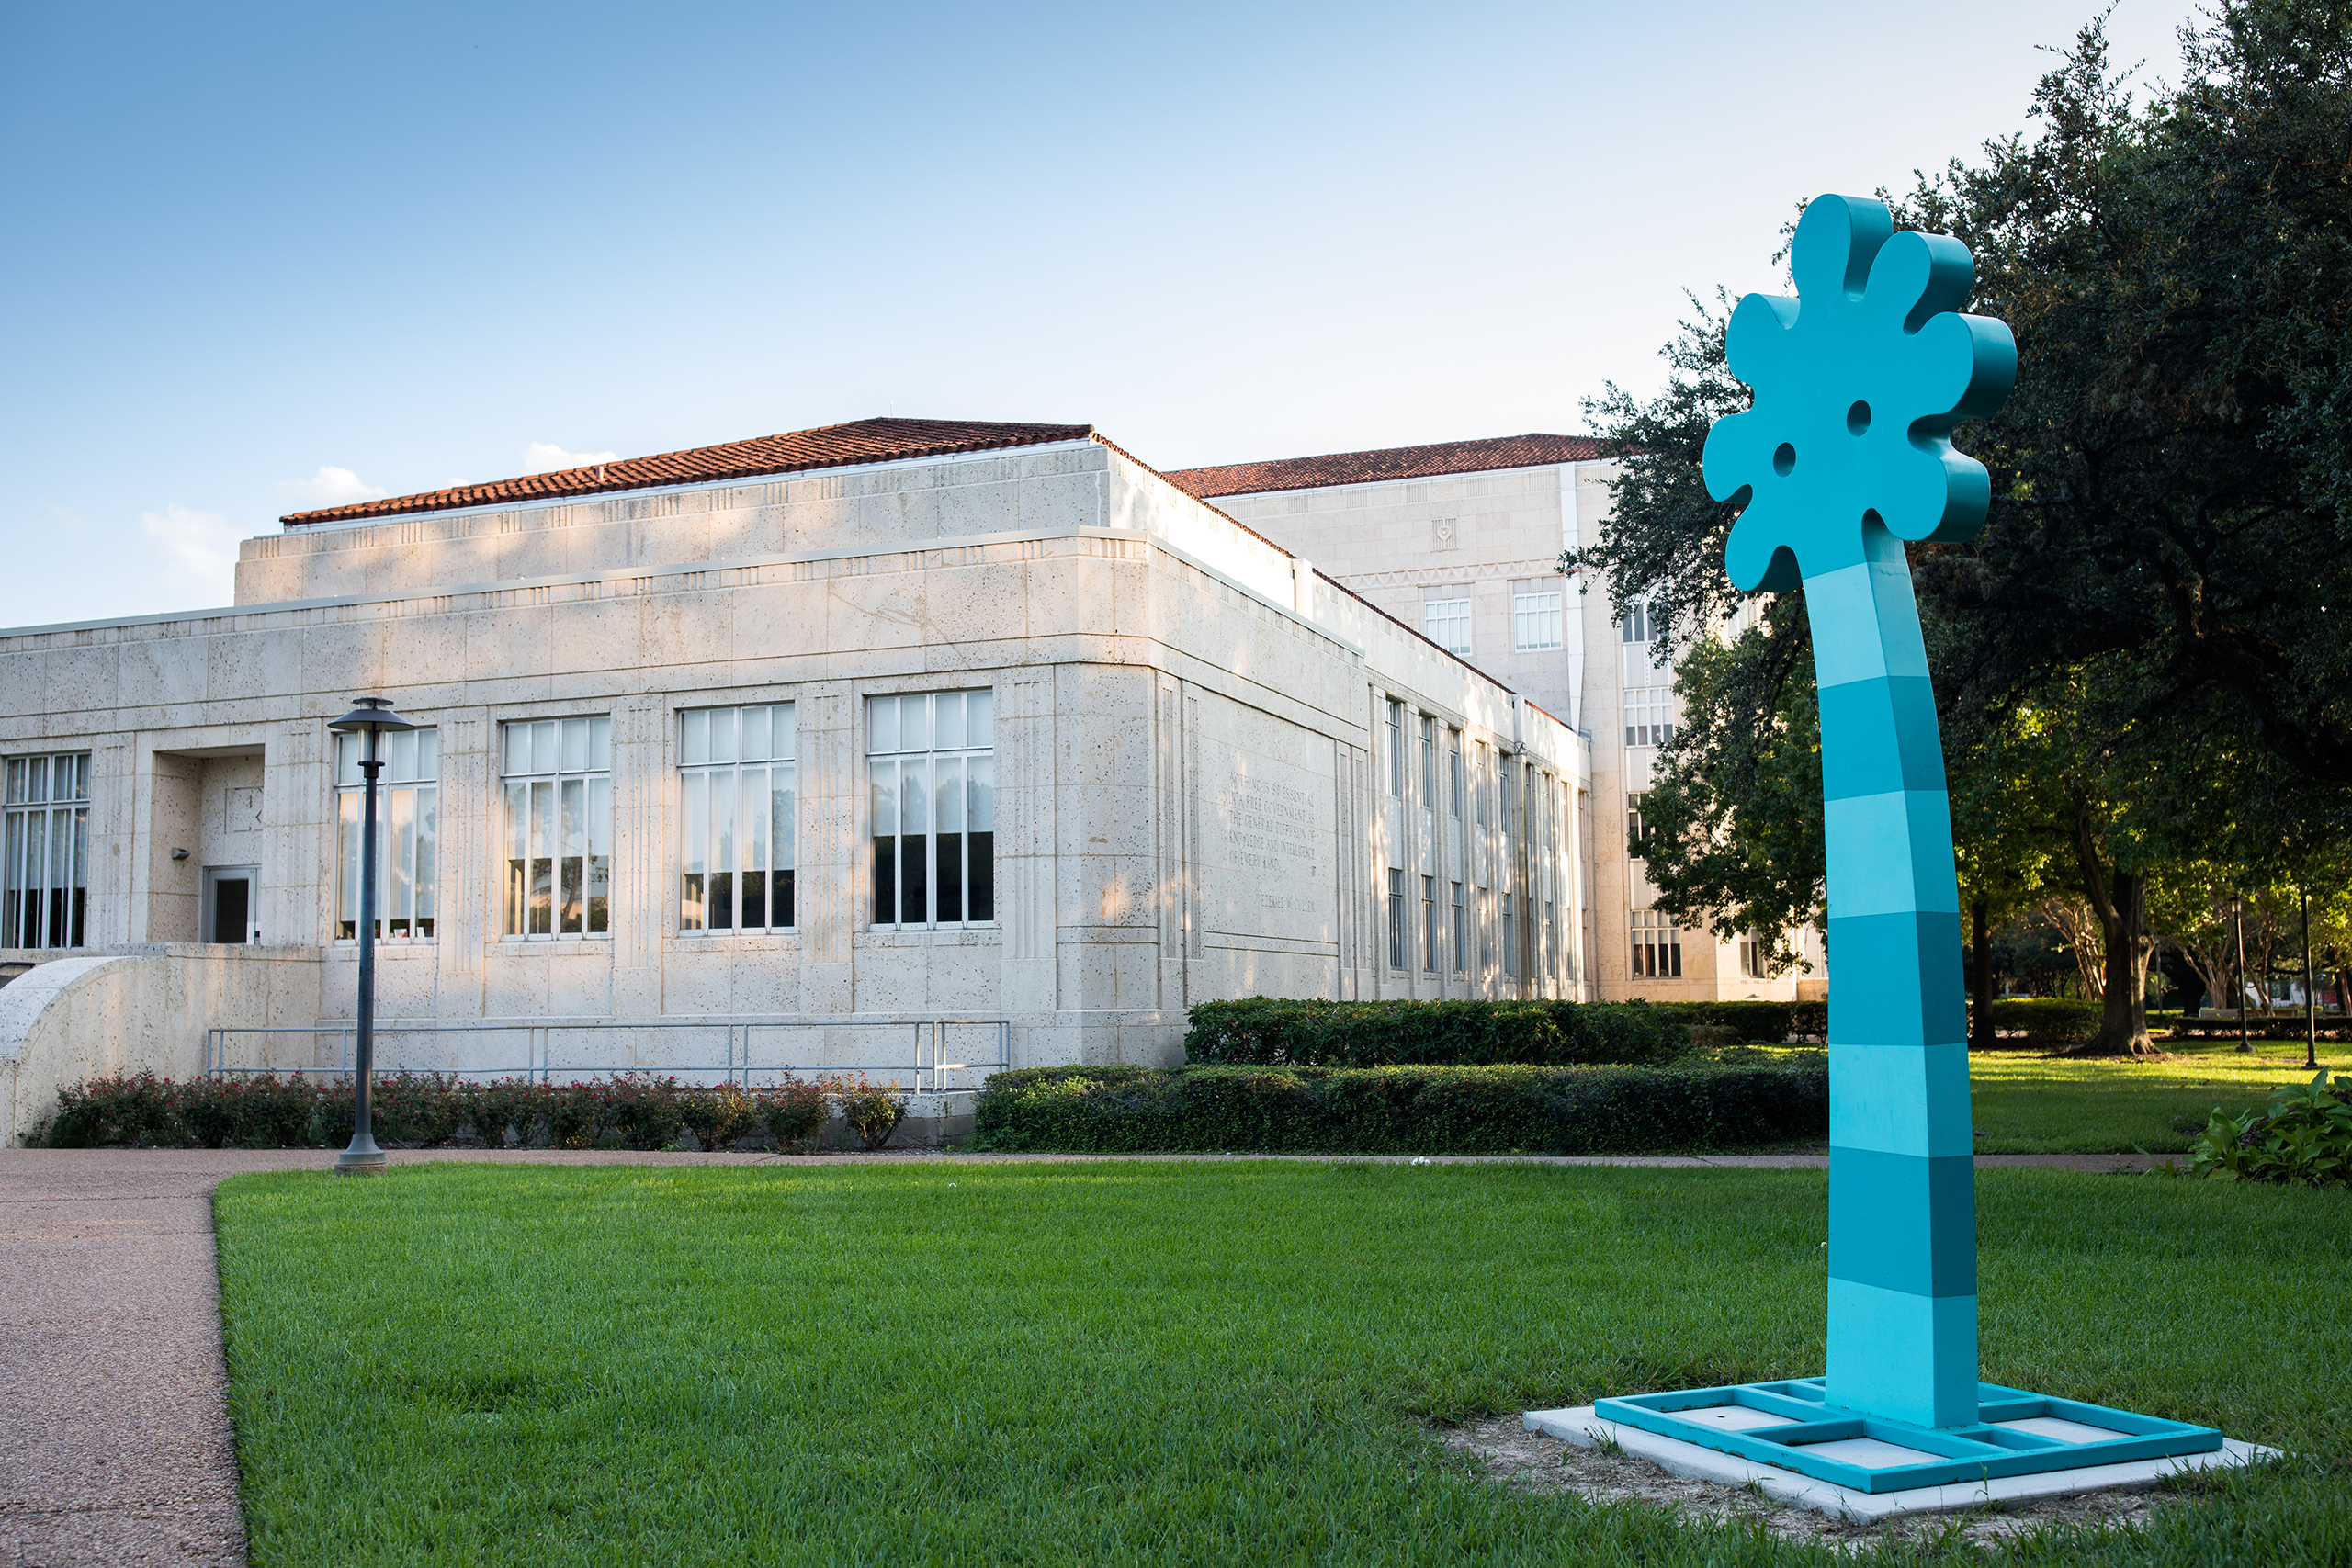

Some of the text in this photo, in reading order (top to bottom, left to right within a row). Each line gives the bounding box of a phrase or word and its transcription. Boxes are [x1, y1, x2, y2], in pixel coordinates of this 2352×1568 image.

[1229, 771, 1261, 793] NOTHING
[1246, 794, 1261, 812] FREE
[1263, 799, 1305, 823] GOVERNMENT
[1229, 809, 1242, 826] THE
[1245, 814, 1272, 832] GENERAL
[1229, 830, 1315, 860] KNOWLEDGE AND INTELLIGENCE
[1240, 852, 1260, 868] EVERY
[1261, 894, 1283, 909] EZEKIEL
